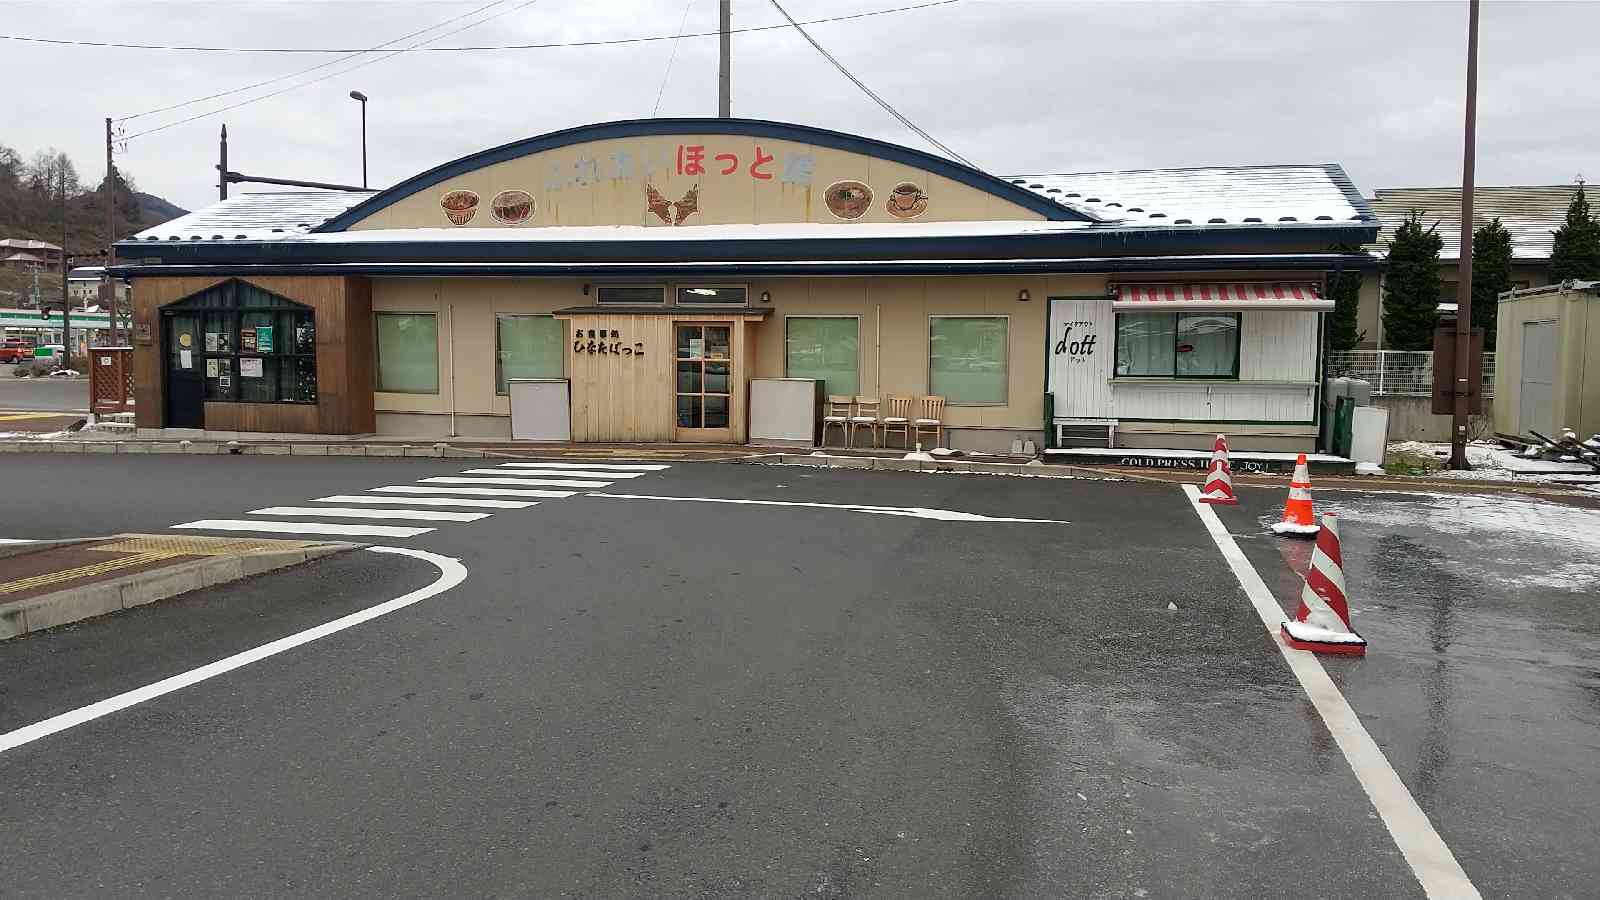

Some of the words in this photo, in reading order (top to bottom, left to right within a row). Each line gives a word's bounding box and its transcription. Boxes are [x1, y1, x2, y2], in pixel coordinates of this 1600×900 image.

[1055, 326, 1097, 355] dott
[1121, 457, 1154, 466] COLD
[1157, 459, 1196, 468] PRESS
